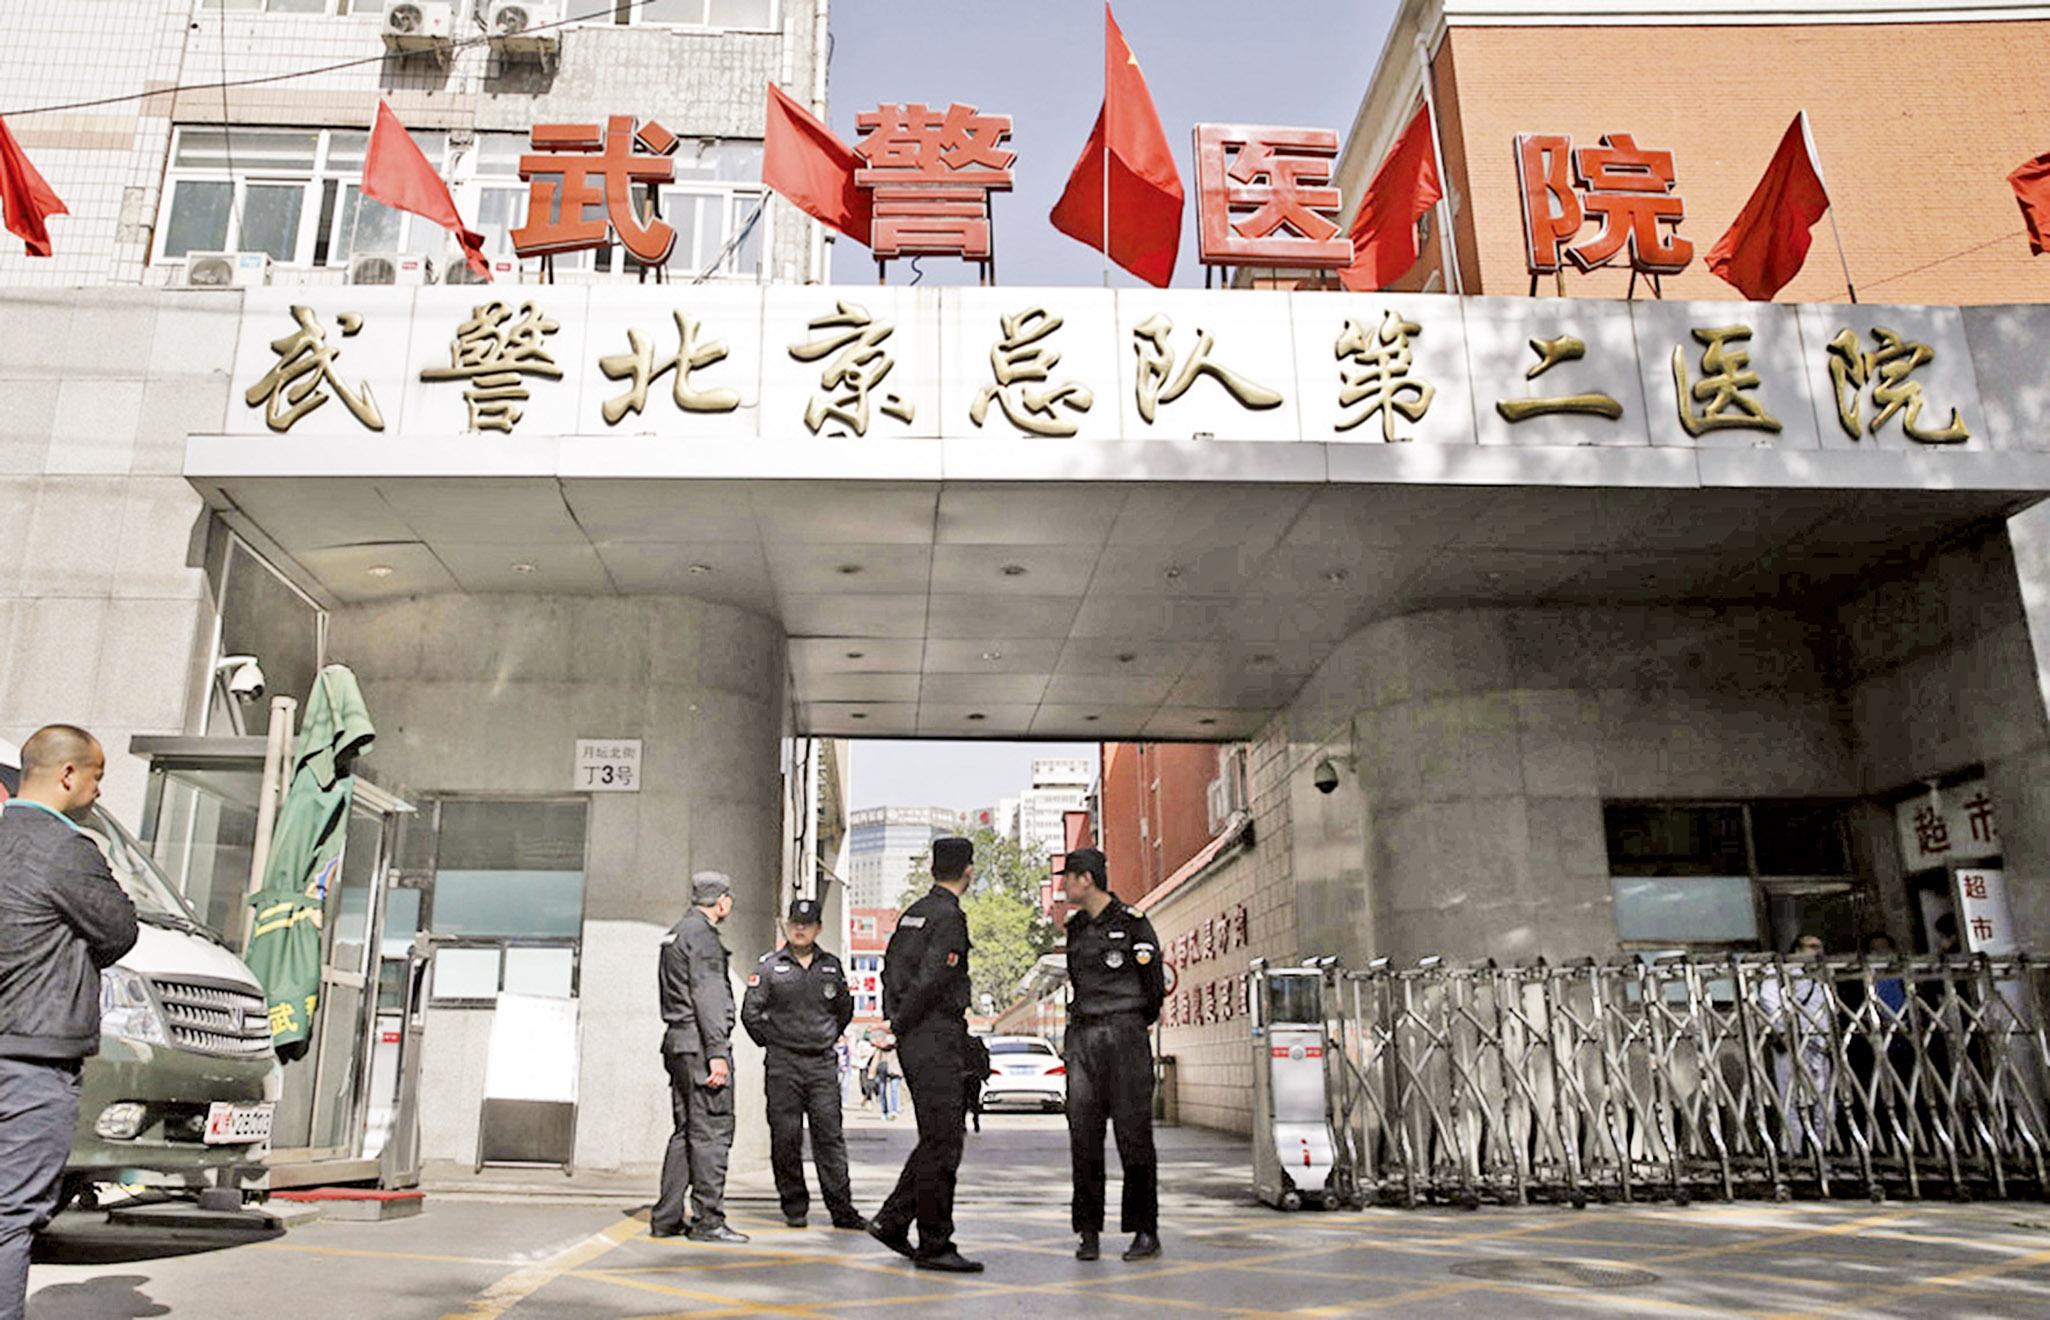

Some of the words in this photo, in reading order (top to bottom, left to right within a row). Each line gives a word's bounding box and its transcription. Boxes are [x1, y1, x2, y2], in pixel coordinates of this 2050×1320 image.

[511, 102, 1695, 275] 武警医院
[243, 301, 1969, 444] 武警北京总队第二医院
[583, 764, 634, 786] 丁3号
[1912, 792, 1998, 856] 超市
[1963, 874, 1993, 942] 超市
